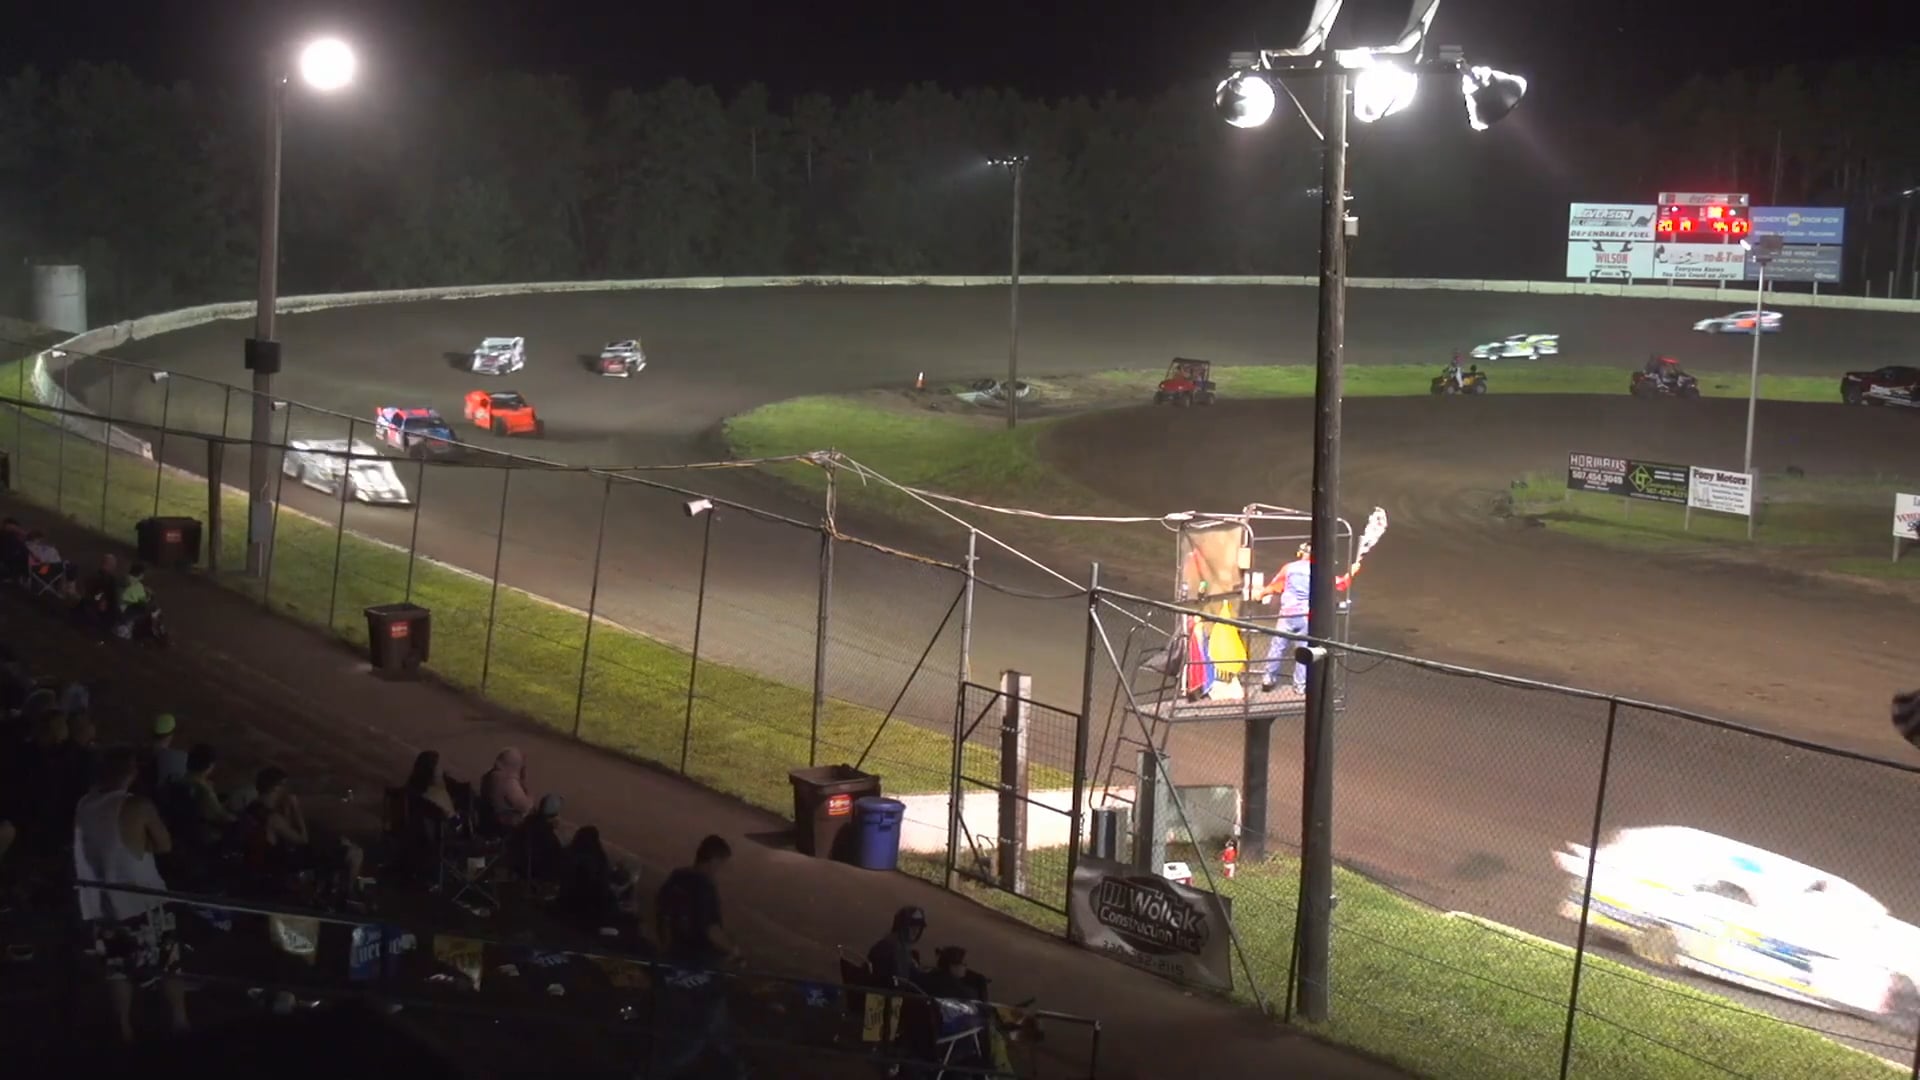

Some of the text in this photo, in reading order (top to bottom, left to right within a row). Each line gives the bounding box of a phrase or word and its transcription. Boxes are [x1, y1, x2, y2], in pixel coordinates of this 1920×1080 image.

[1570, 230, 1650, 239] DEPENDABLE FUEL
[1595, 253, 1629, 264] WILSON
[1716, 472, 1746, 486] Motors
[1100, 906, 1173, 944] Construction
